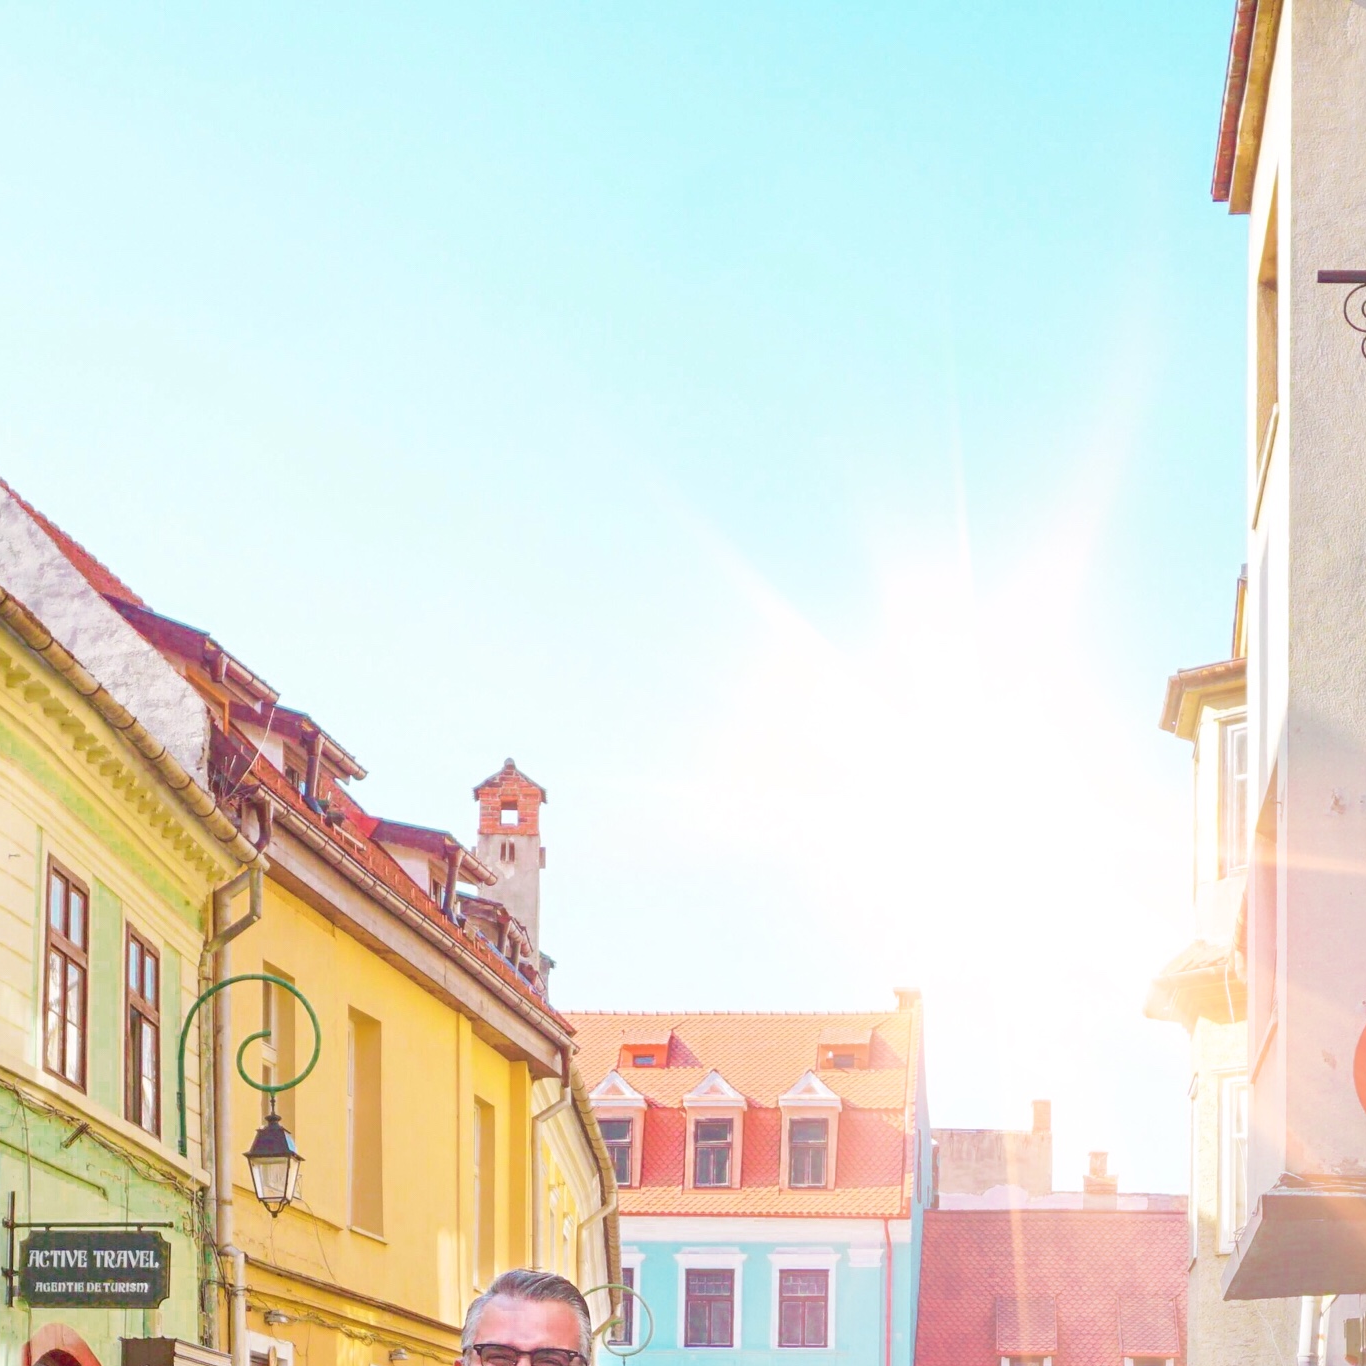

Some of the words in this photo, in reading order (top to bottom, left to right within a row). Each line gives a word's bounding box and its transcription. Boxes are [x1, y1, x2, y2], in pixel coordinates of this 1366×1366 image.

[27, 1249, 88, 1268] ACTIVE
[34, 1281, 84, 1294] AGENTIE
[86, 1282, 102, 1293] DE
[103, 1282, 149, 1294] TURISM
